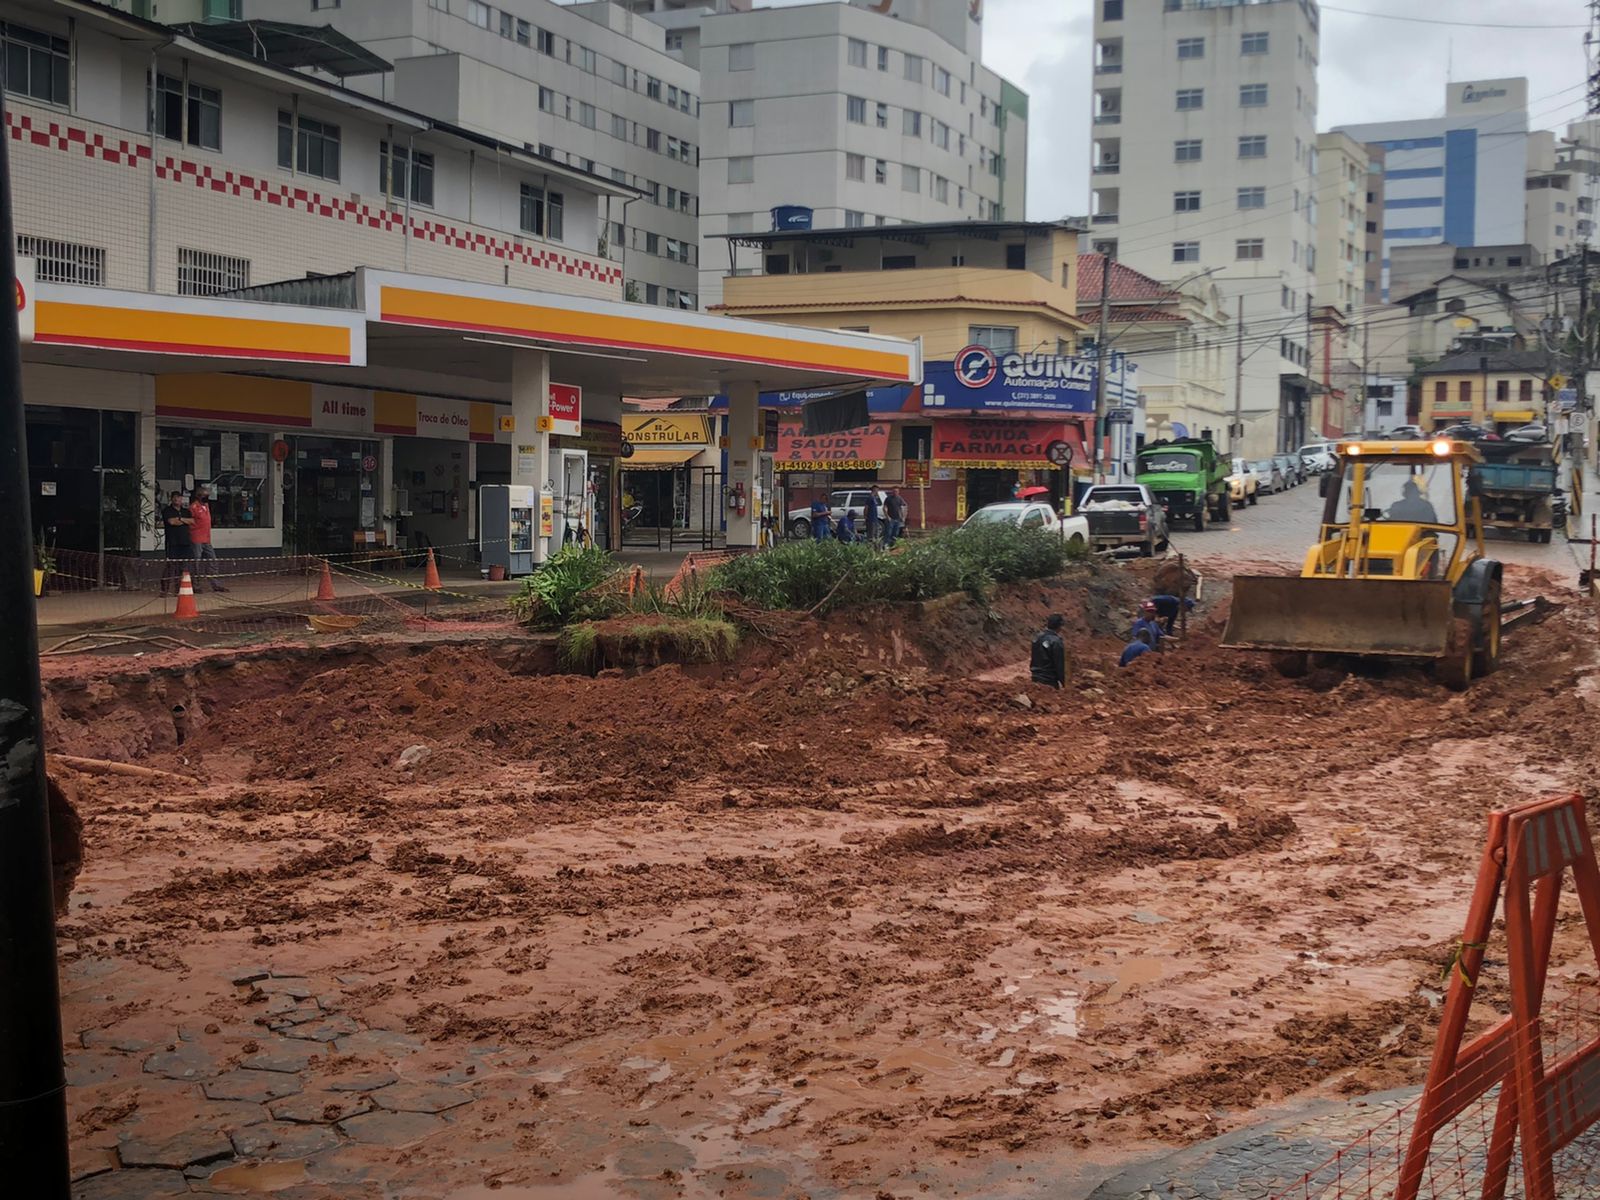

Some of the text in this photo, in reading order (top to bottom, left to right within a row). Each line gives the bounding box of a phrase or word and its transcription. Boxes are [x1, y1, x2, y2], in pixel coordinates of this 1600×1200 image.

[1003, 377, 1058, 390] Automação
[322, 400, 366, 417] All time
[549, 401, 574, 413] -Power
[418, 411, 468, 426] Troca de Óleo
[504, 419, 511, 428] 4
[541, 419, 548, 428] 3
[791, 436, 862, 449] SAÚDE
[940, 441, 1046, 455] FARMACI
[811, 450, 858, 459] VIDA
